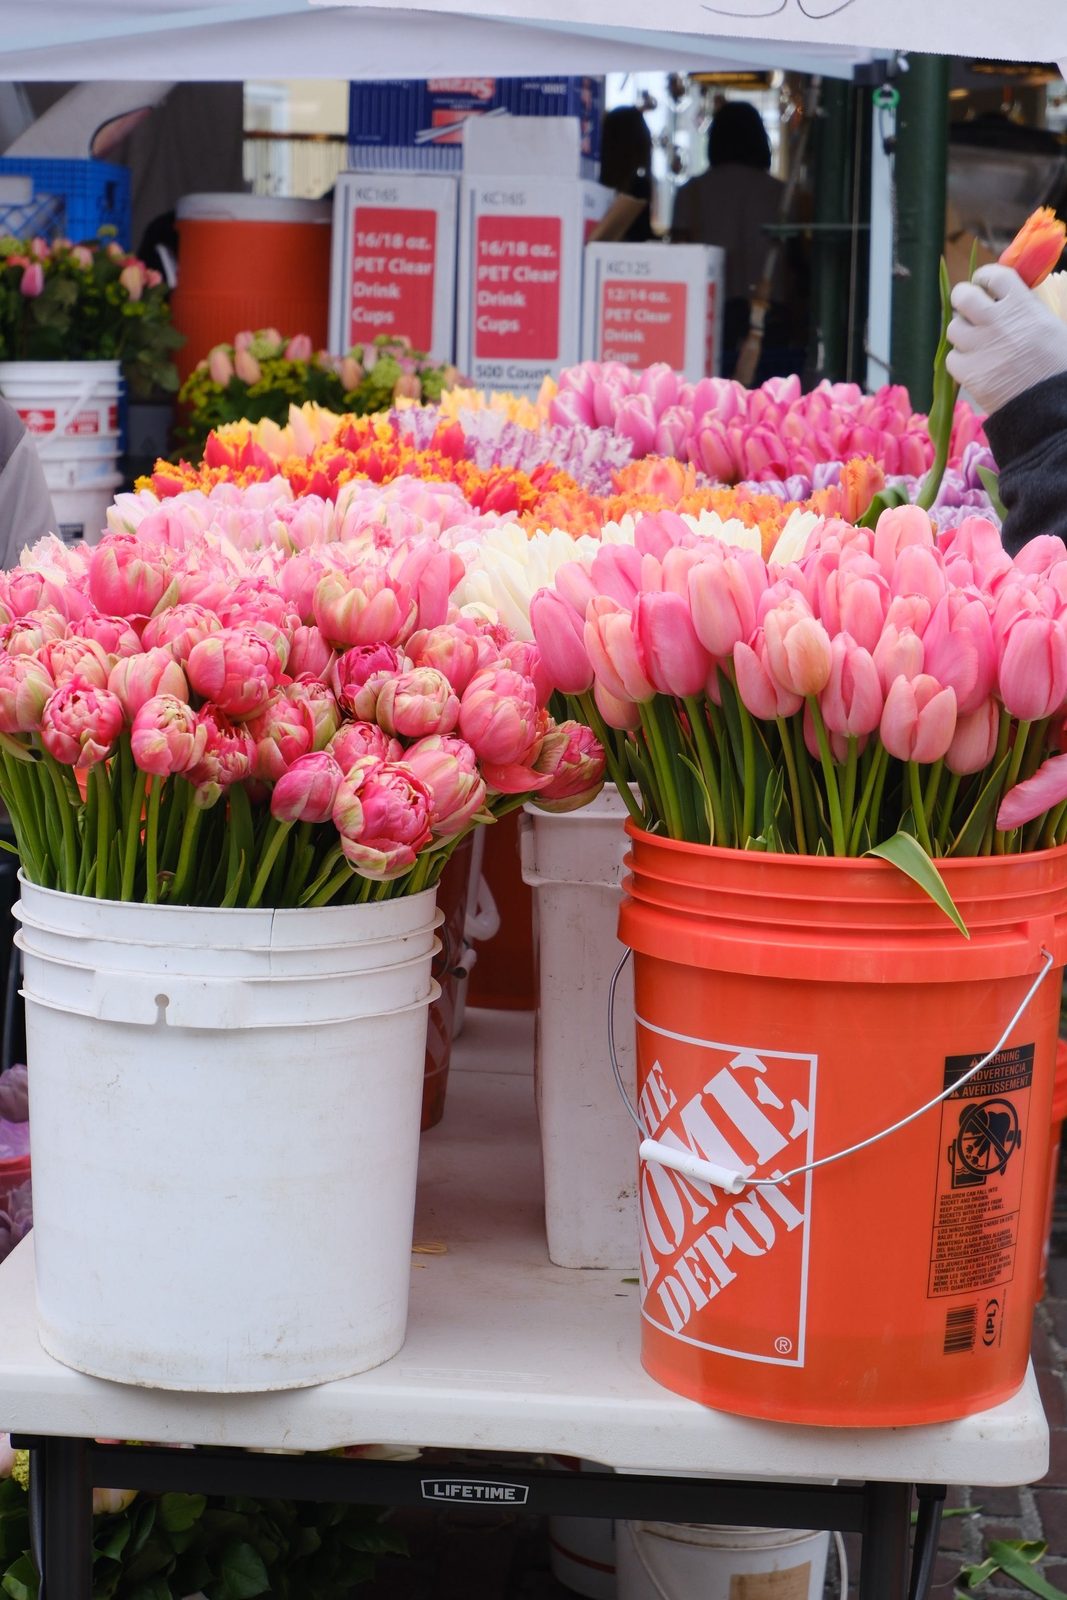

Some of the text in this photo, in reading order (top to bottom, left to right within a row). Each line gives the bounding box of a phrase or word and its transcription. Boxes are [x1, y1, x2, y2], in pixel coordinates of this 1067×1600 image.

[356, 232, 432, 251] 16/18 oz.
[479, 241, 556, 258] 16/18 oz.
[354, 256, 432, 275] PET Clear
[478, 265, 559, 283] PET Clear
[352, 281, 400, 299] Drink
[477, 290, 526, 307] Drink
[352, 306, 395, 326] Cups
[605, 308, 672, 323] PET Clear
[477, 316, 520, 335] Cups
[604, 329, 645, 343] Drink
[604, 349, 639, 364] Cups
[476, 365, 503, 378] 500
[969, 1061, 1026, 1082] ADVERTENCIA
[962, 1075, 1029, 1097] AVERTISSEMENT
[639, 1060, 677, 1136] HE
[657, 1168, 805, 1334] DEPOT
[434, 1483, 515, 1500] LIFETIME
